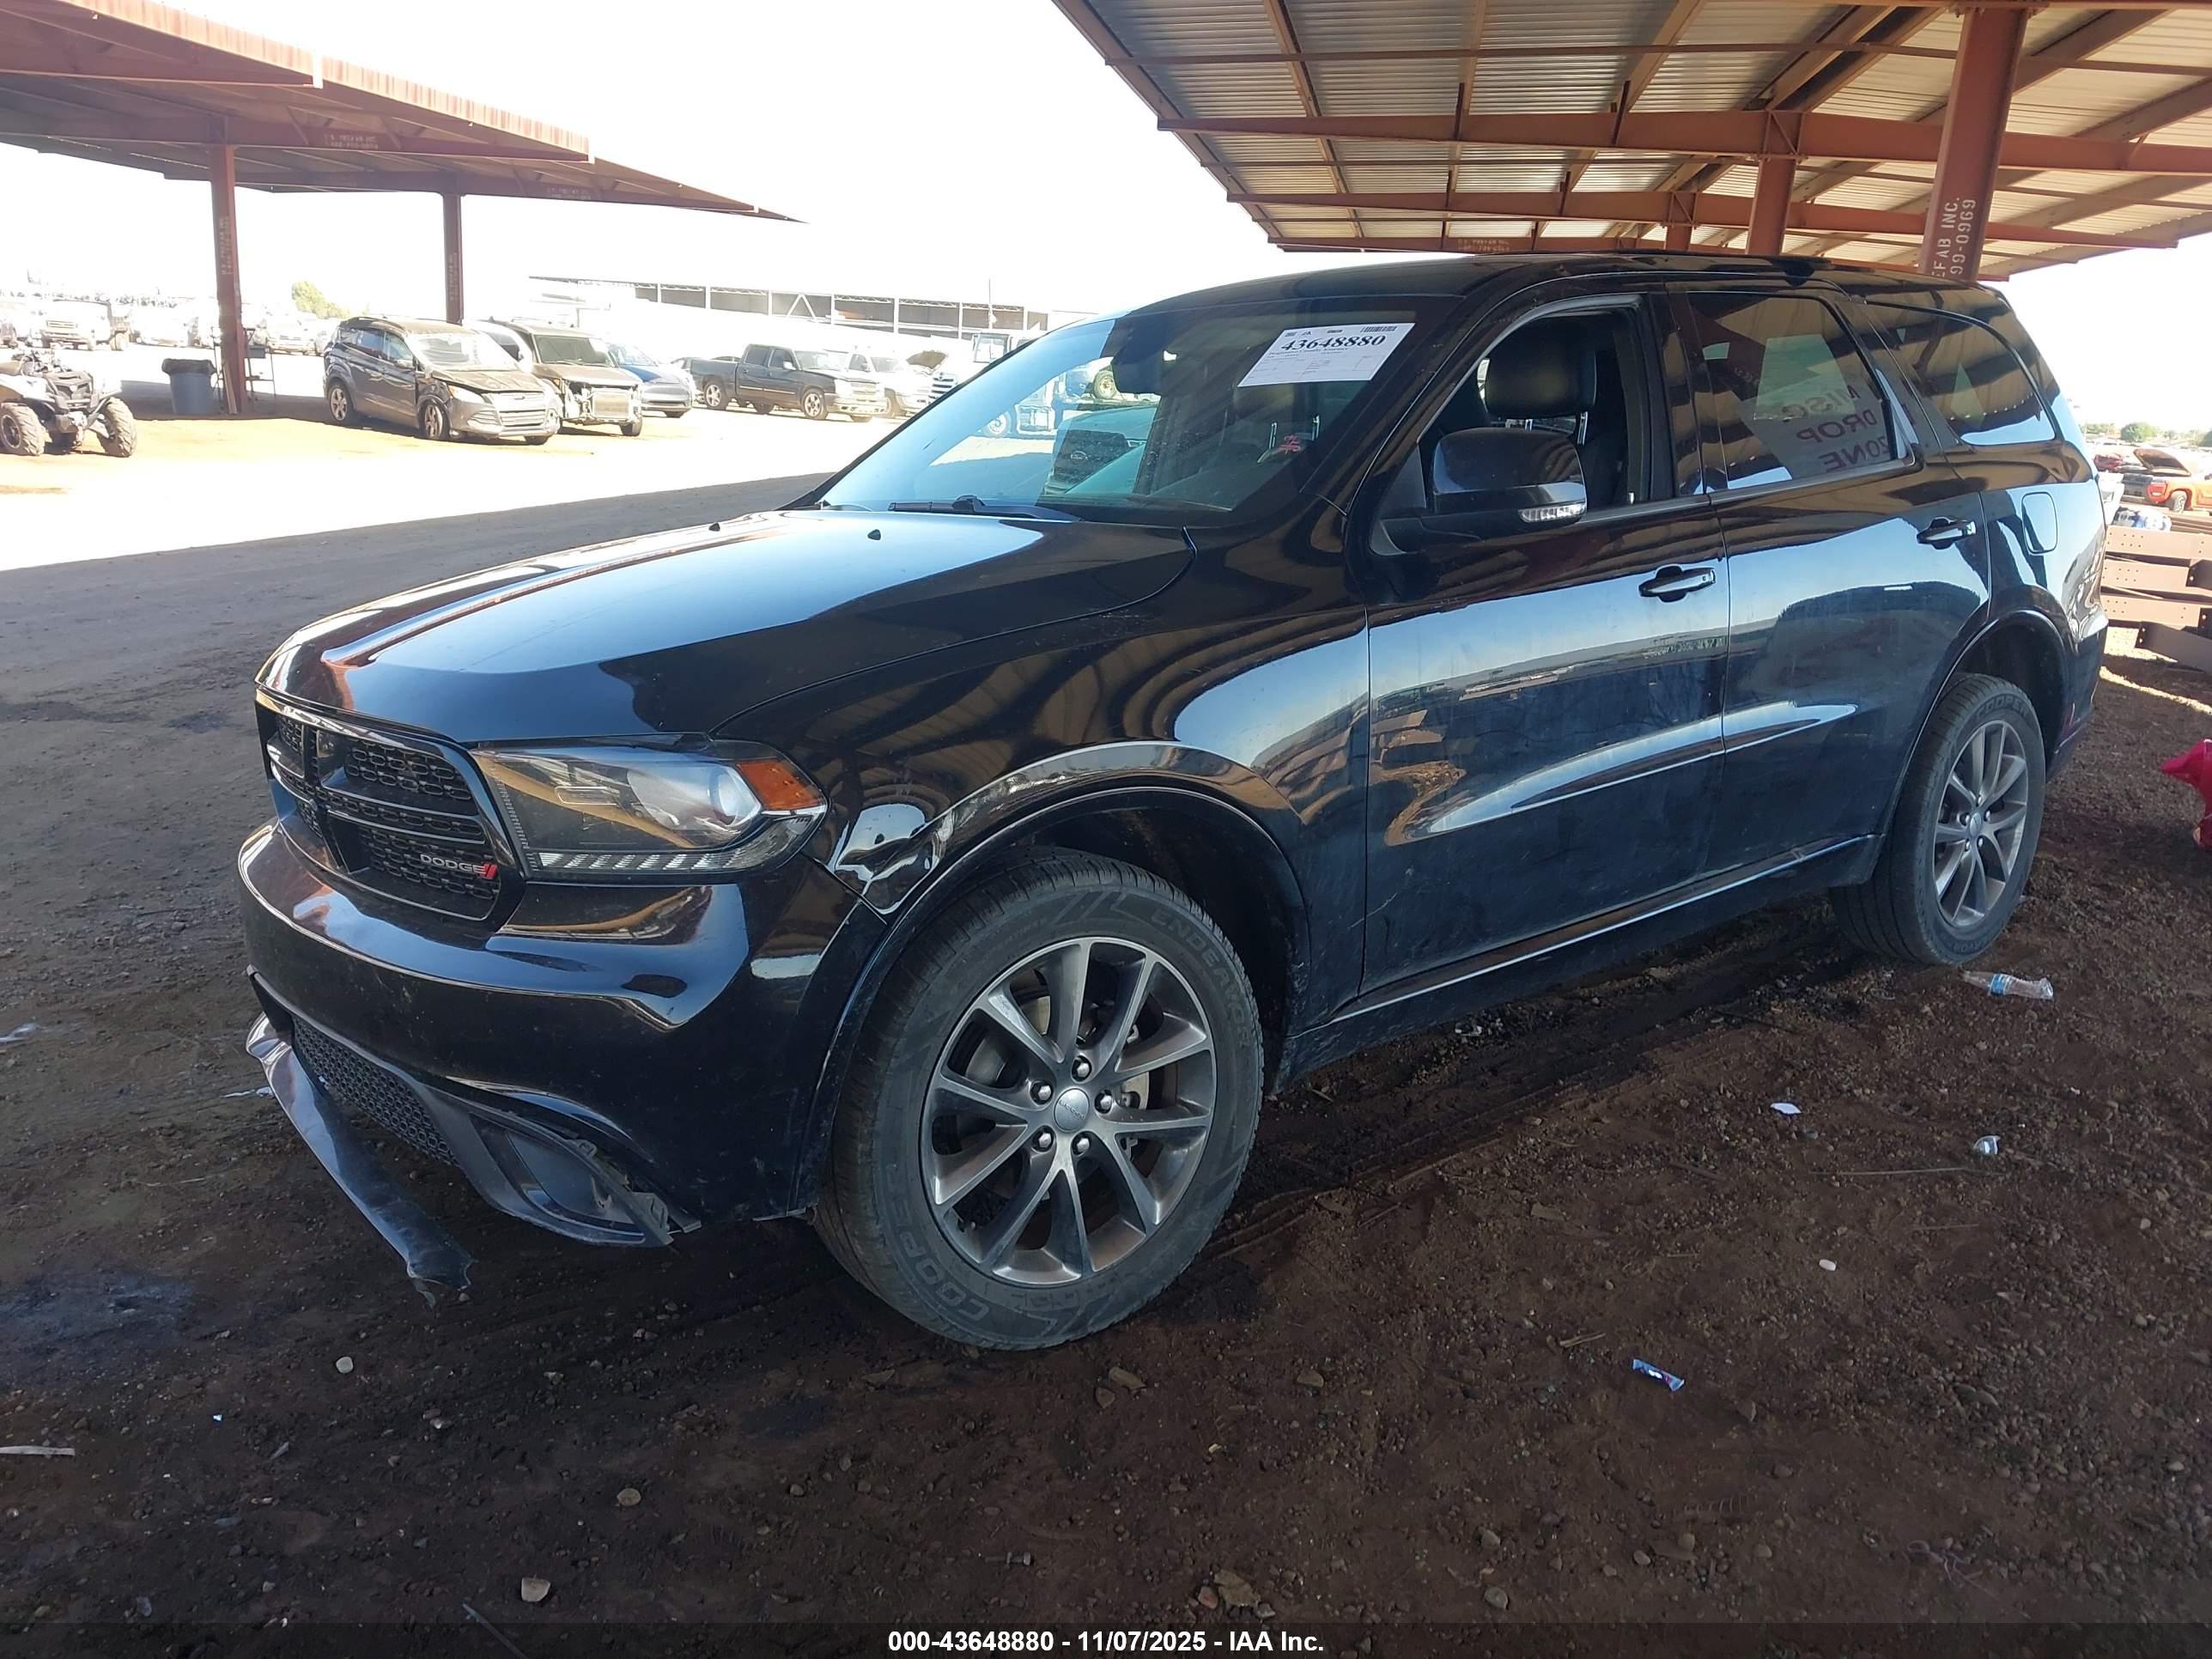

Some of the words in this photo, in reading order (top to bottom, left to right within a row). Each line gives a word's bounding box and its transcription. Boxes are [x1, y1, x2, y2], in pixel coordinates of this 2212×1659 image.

[1941, 197, 1960, 228] INC.
[1281, 336, 1386, 351] 43648880
[421, 854, 486, 875] DODGE
